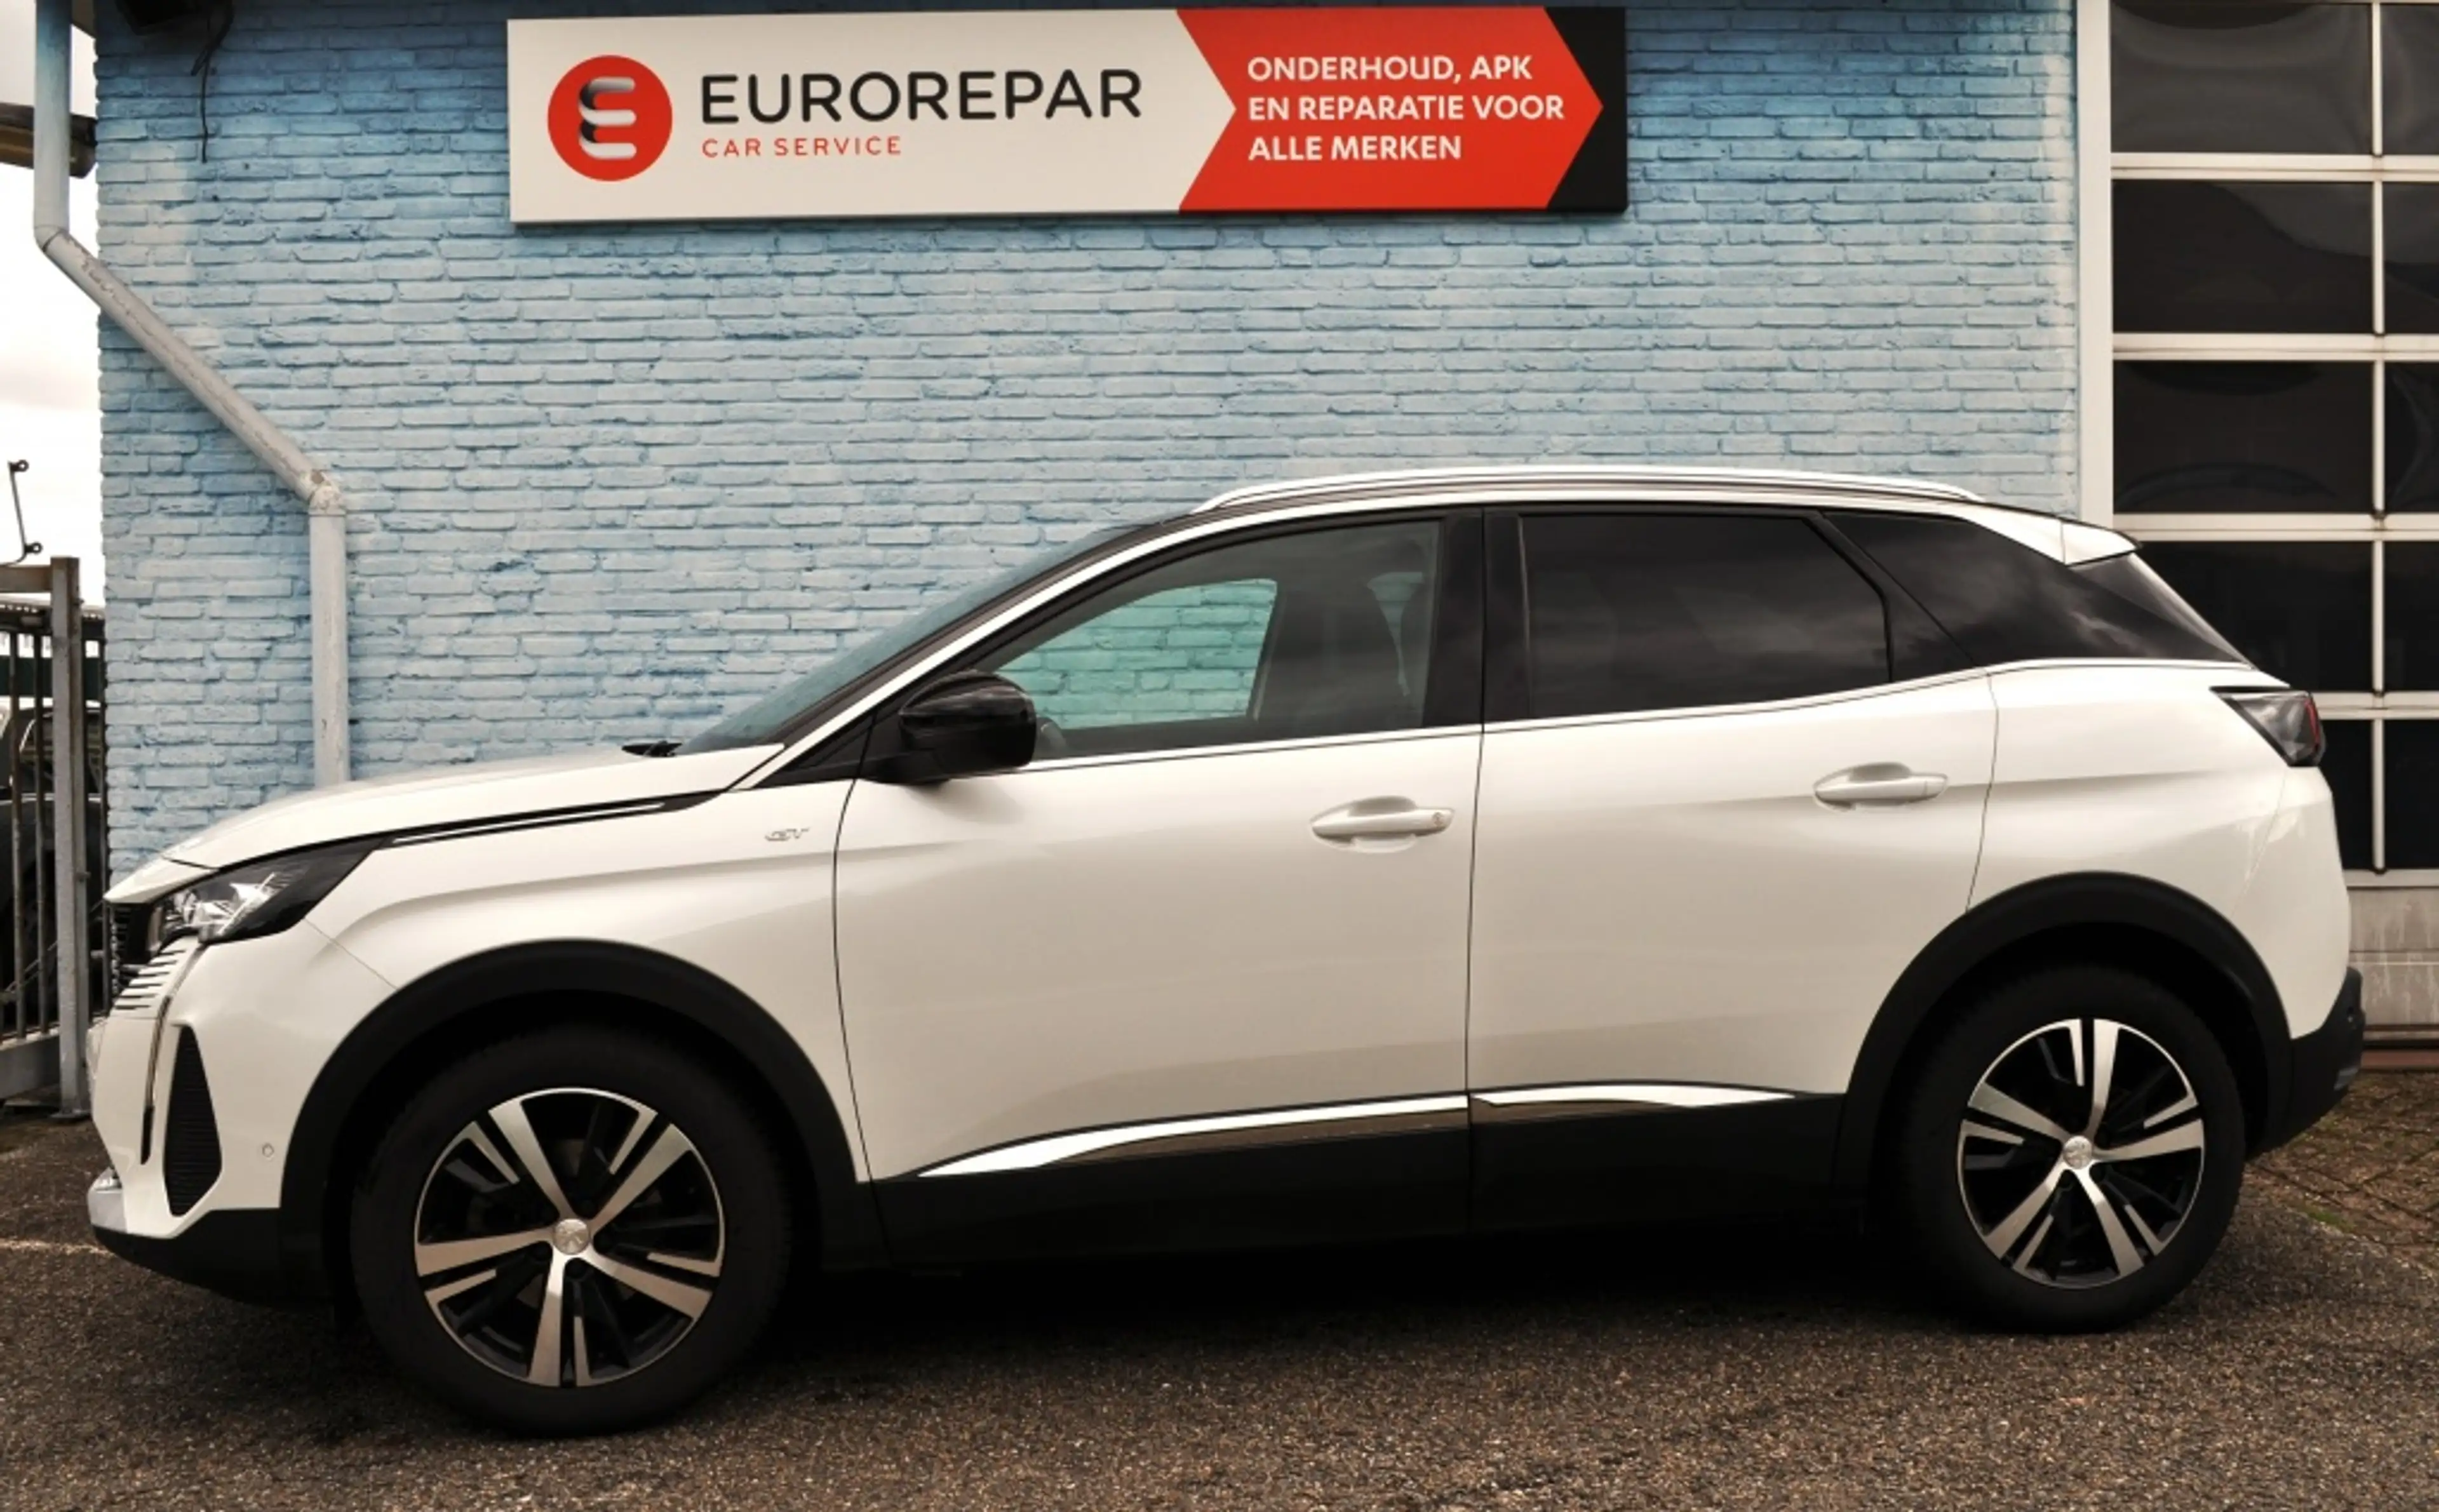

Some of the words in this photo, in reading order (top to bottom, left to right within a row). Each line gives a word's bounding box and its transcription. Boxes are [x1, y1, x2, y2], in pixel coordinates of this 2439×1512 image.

[1247, 56, 1462, 84] ONDERHOUD,
[1469, 55, 1533, 80] APK
[701, 69, 1142, 124] EUROREPAR
[1248, 97, 1291, 121] EN
[1298, 95, 1465, 120] REPARATIE
[1471, 94, 1565, 120] VOOR
[700, 137, 762, 159] CAR
[774, 135, 902, 158] SERVICE
[1247, 137, 1323, 161] ALLE
[1331, 135, 1462, 161] MERKEN
